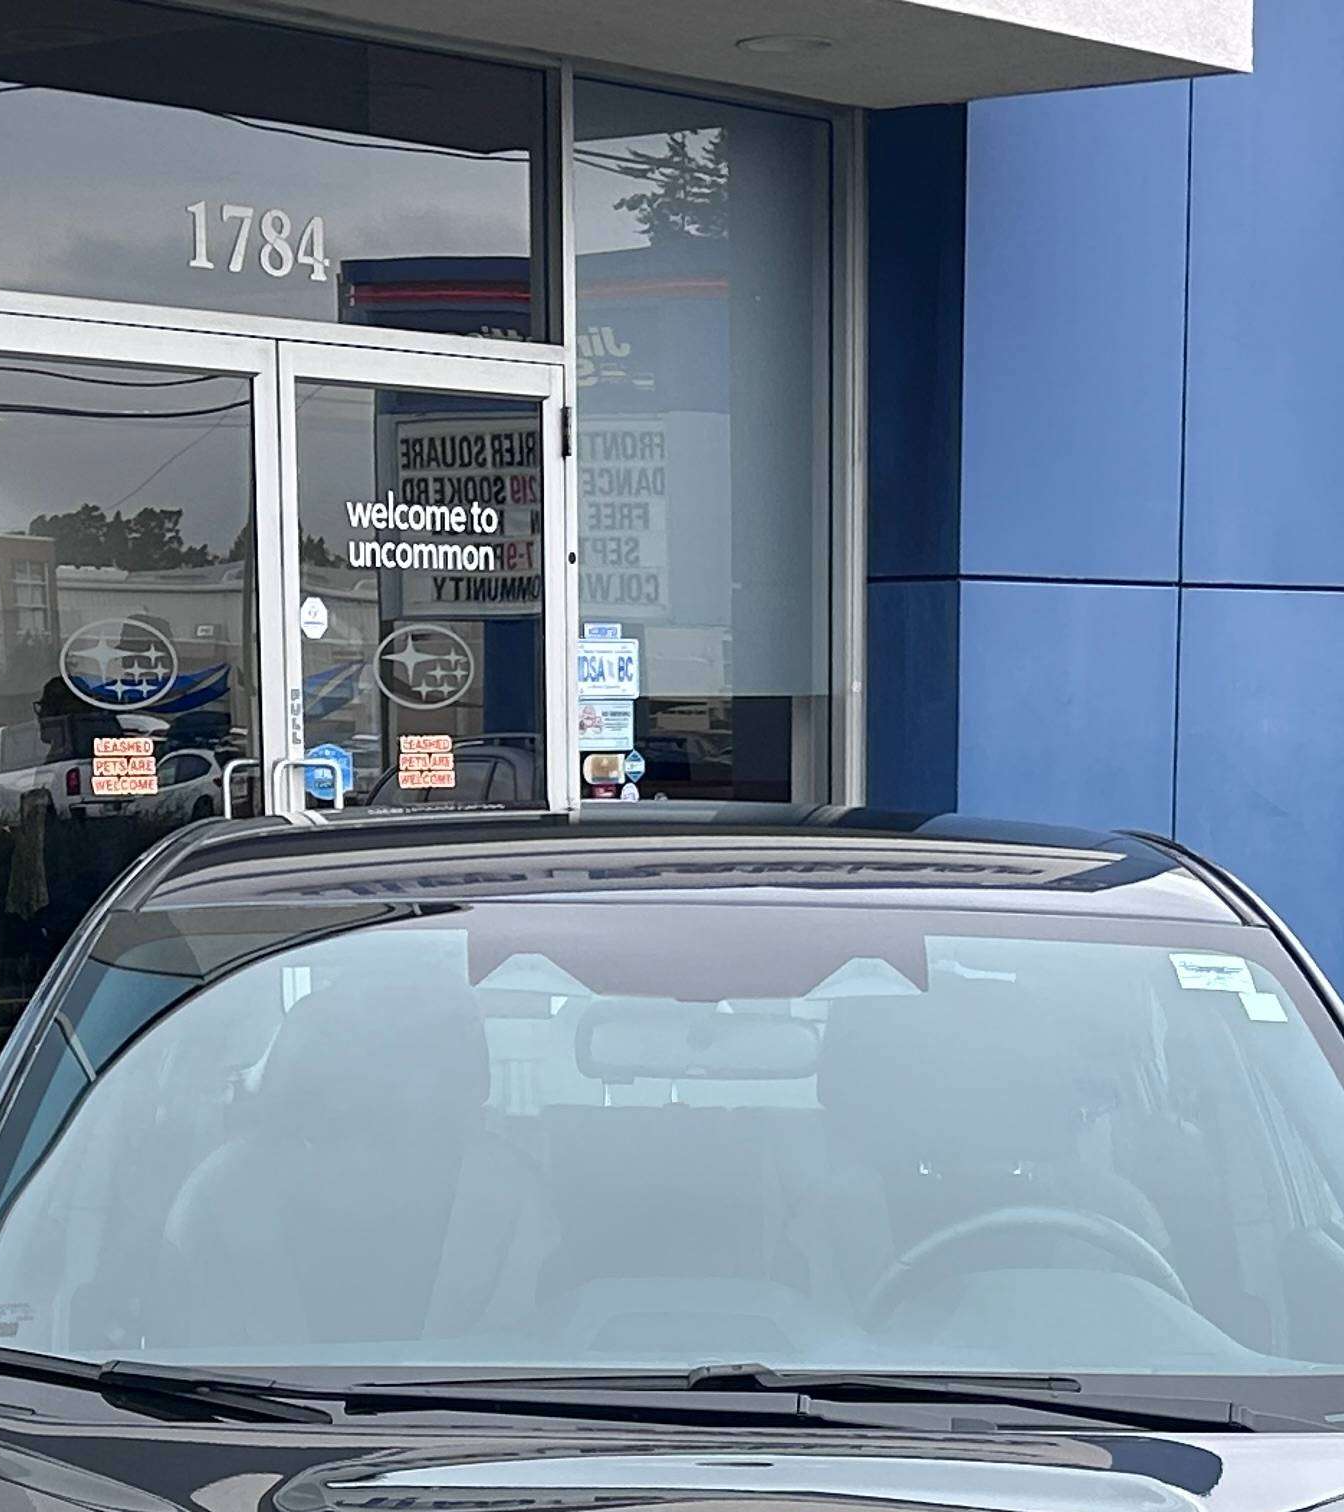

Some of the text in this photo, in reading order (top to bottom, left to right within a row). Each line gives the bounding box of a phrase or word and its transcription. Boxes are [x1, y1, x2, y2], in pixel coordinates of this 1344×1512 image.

[187, 200, 330, 282] 1784
[346, 490, 466, 533] welcome
[471, 501, 499, 534] to
[348, 540, 496, 571] uncommon
[96, 739, 151, 753] LEASHED
[95, 760, 154, 772] PETS ARE
[94, 779, 156, 792] WELCOME
